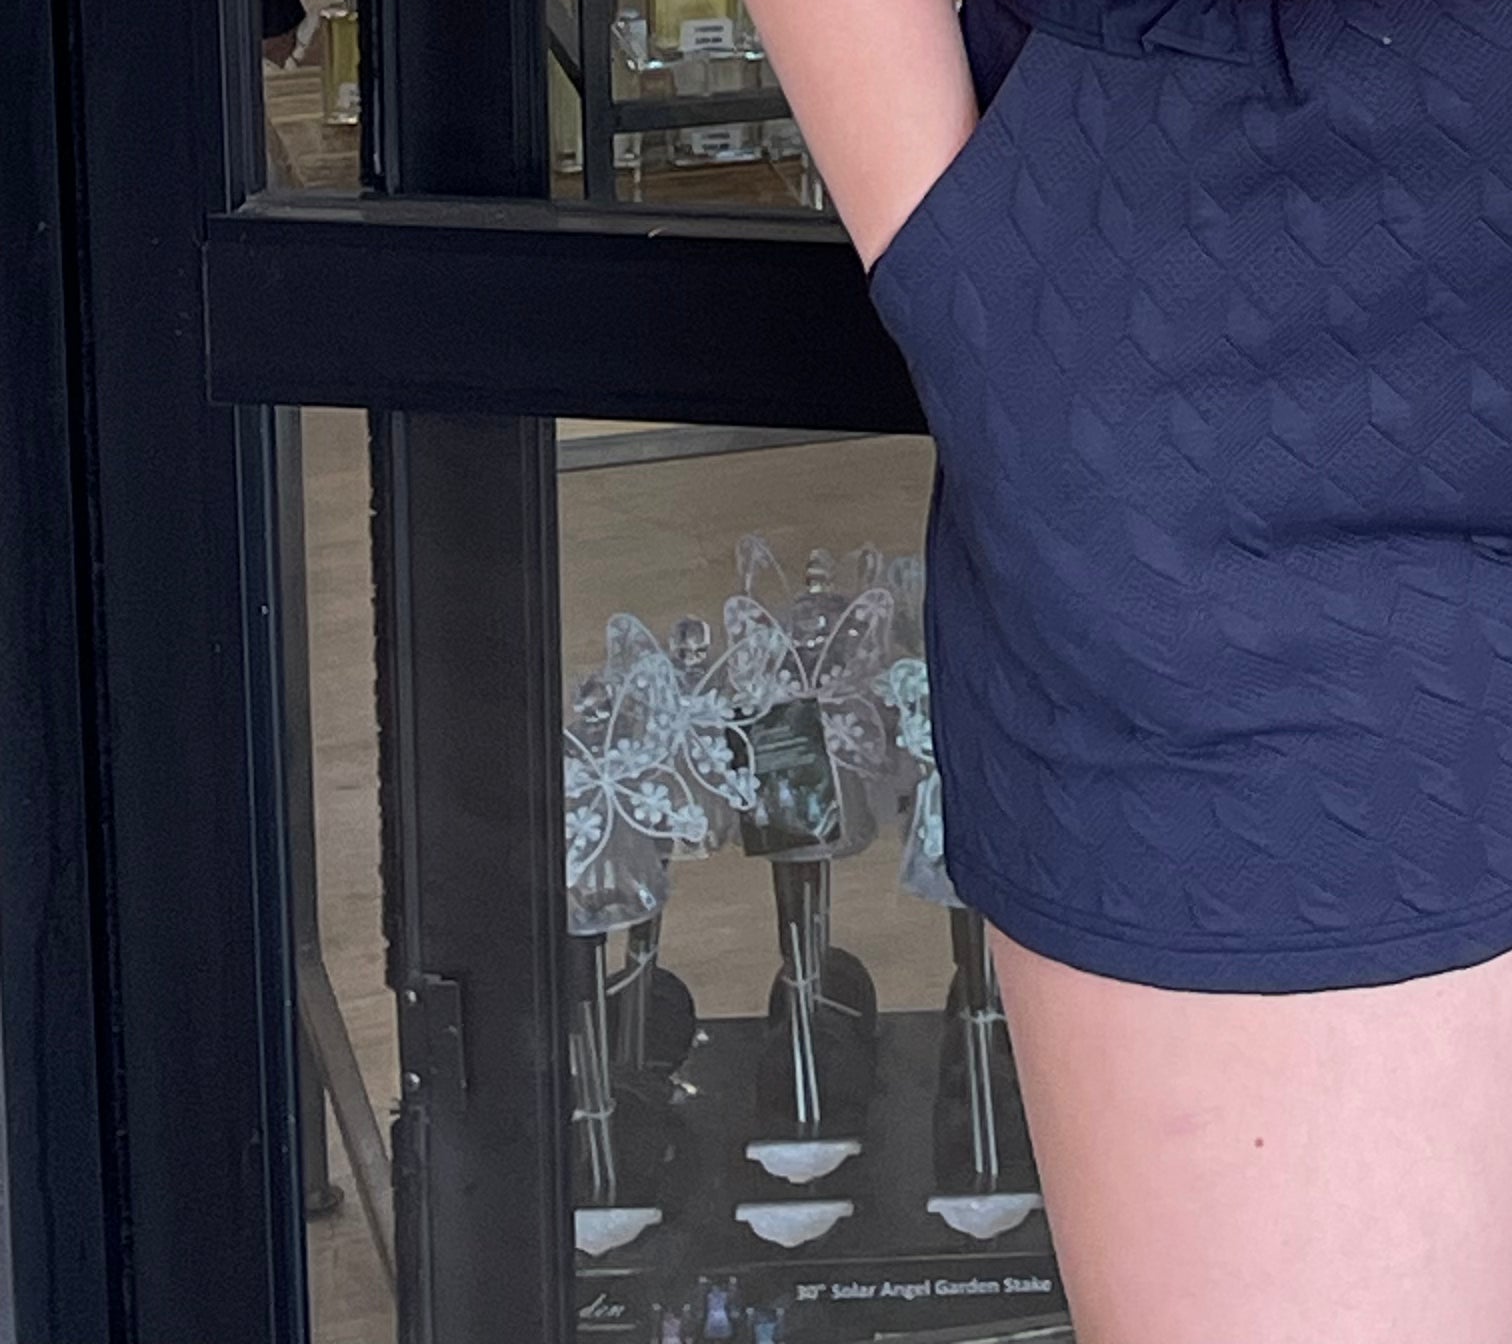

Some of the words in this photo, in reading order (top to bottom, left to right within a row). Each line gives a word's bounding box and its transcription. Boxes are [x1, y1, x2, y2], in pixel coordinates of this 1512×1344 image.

[831, 1283, 876, 1299] Solar
[880, 1280, 931, 1300] Angel
[935, 1278, 999, 1295] Garden
[1003, 1277, 1052, 1293] Stake
